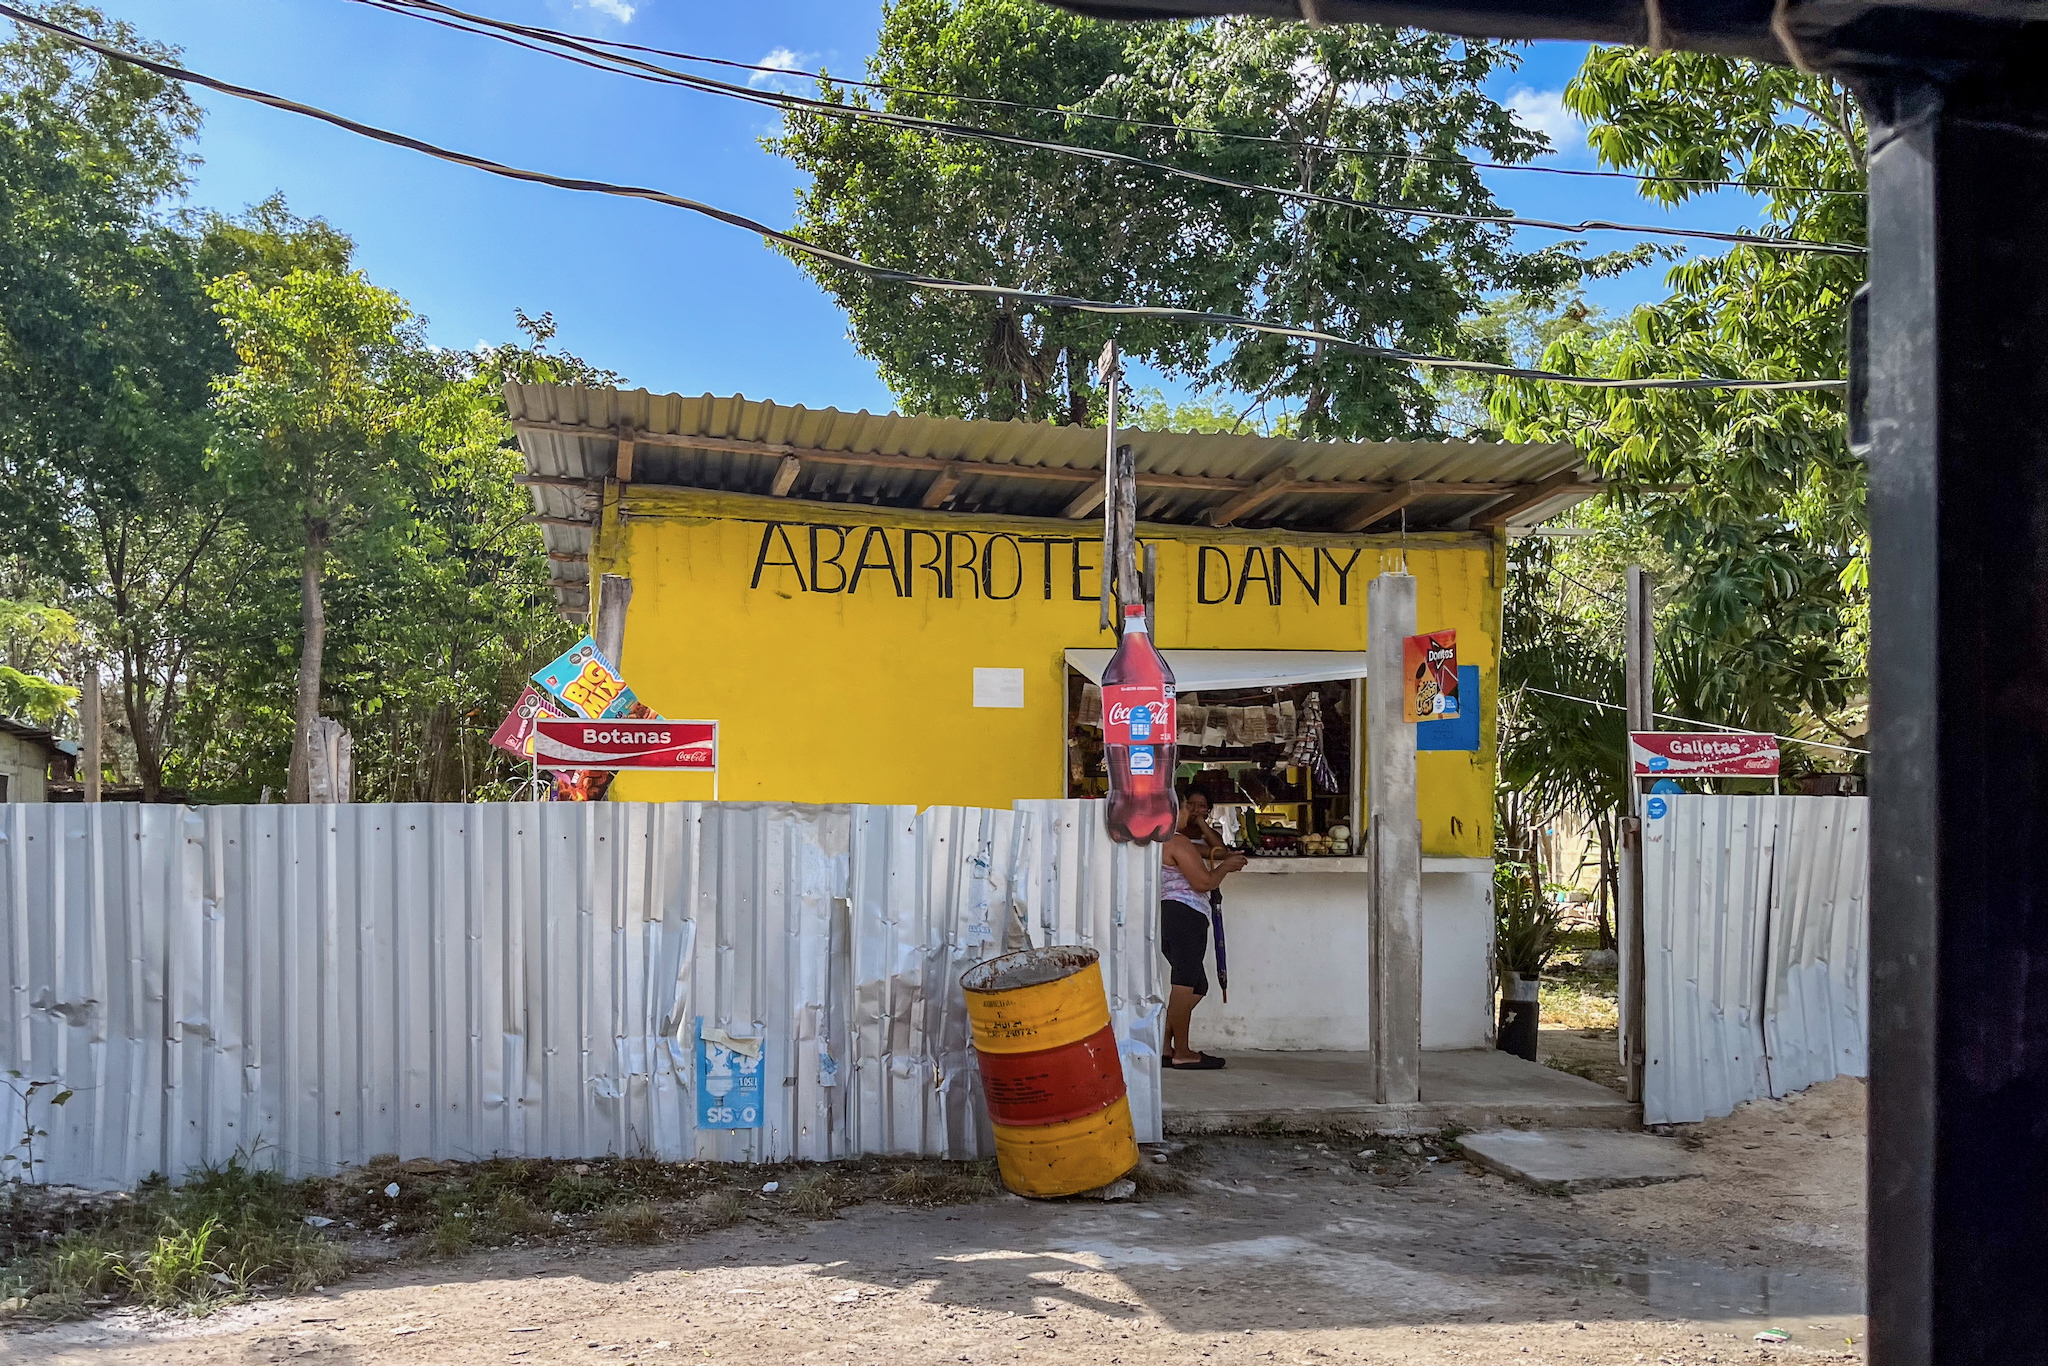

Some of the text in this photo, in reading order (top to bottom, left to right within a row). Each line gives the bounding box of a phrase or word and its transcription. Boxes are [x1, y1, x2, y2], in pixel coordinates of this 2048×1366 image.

[1197, 545, 1362, 606] DANY
[562, 660, 608, 706] BIG
[582, 673, 627, 719] MIX
[582, 728, 672, 744] Botanas
[1669, 740, 1741, 755] Galletas
